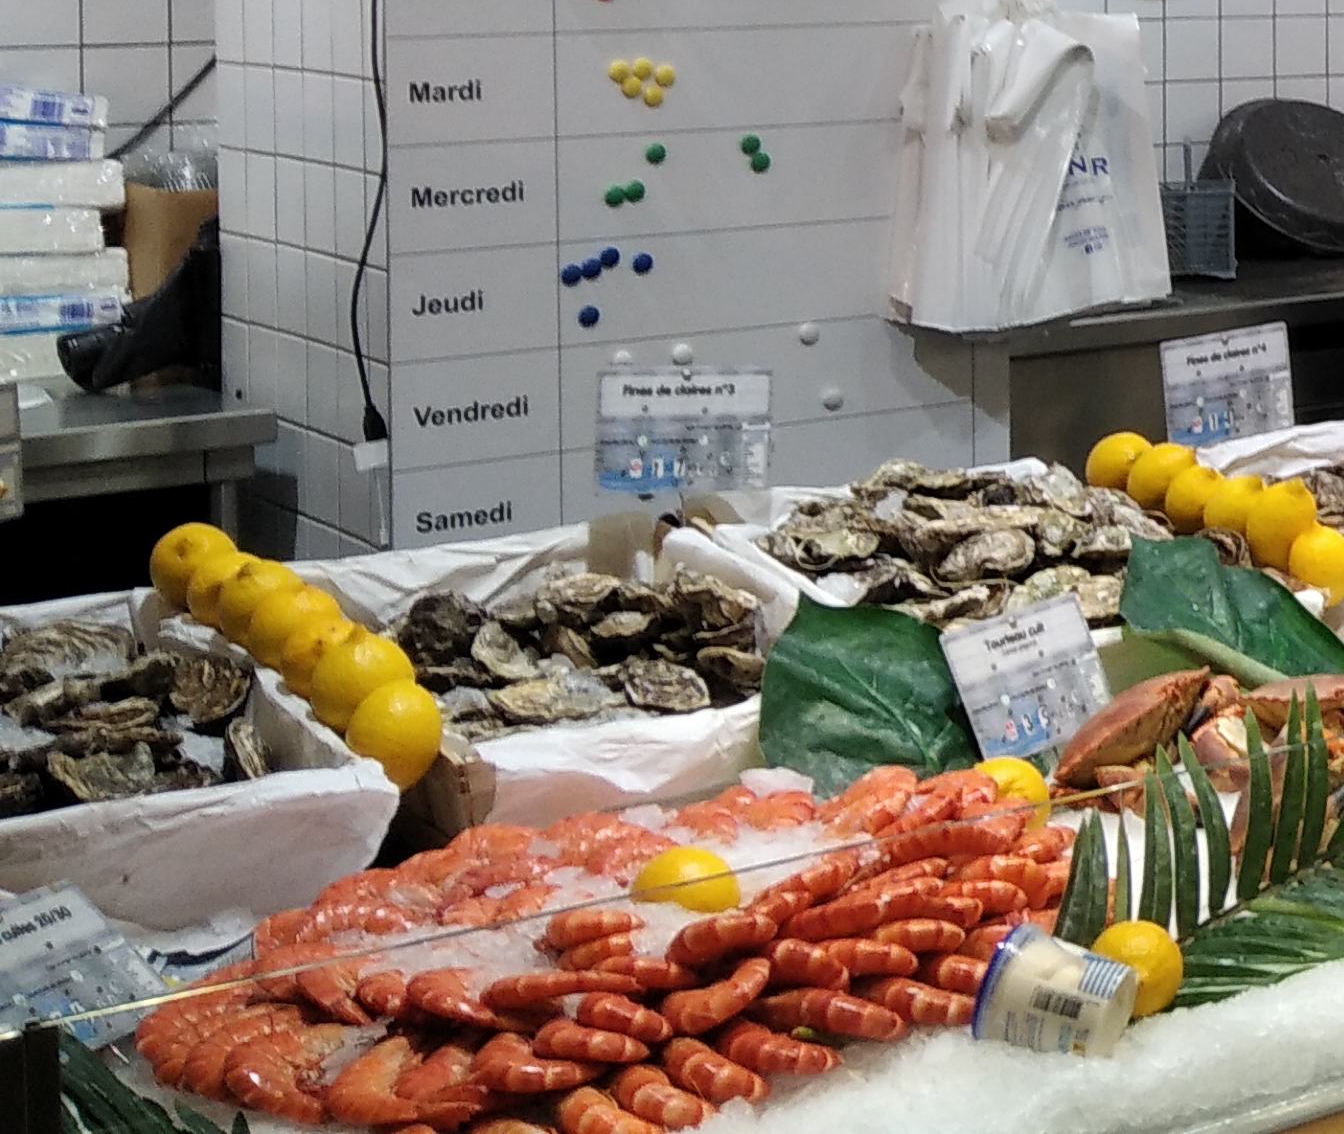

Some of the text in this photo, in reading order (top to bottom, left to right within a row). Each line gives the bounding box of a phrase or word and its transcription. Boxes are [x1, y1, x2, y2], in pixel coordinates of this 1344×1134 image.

[409, 79, 482, 103] Mardi
[411, 179, 525, 208] Mercredi
[412, 289, 484, 316] Jeudi
[622, 384, 653, 396] Fines
[656, 384, 672, 396] de
[674, 384, 712, 396] claires
[413, 394, 529, 428] Vendredi
[416, 500, 512, 533] Samedi
[984, 630, 1026, 651] Tourteau
